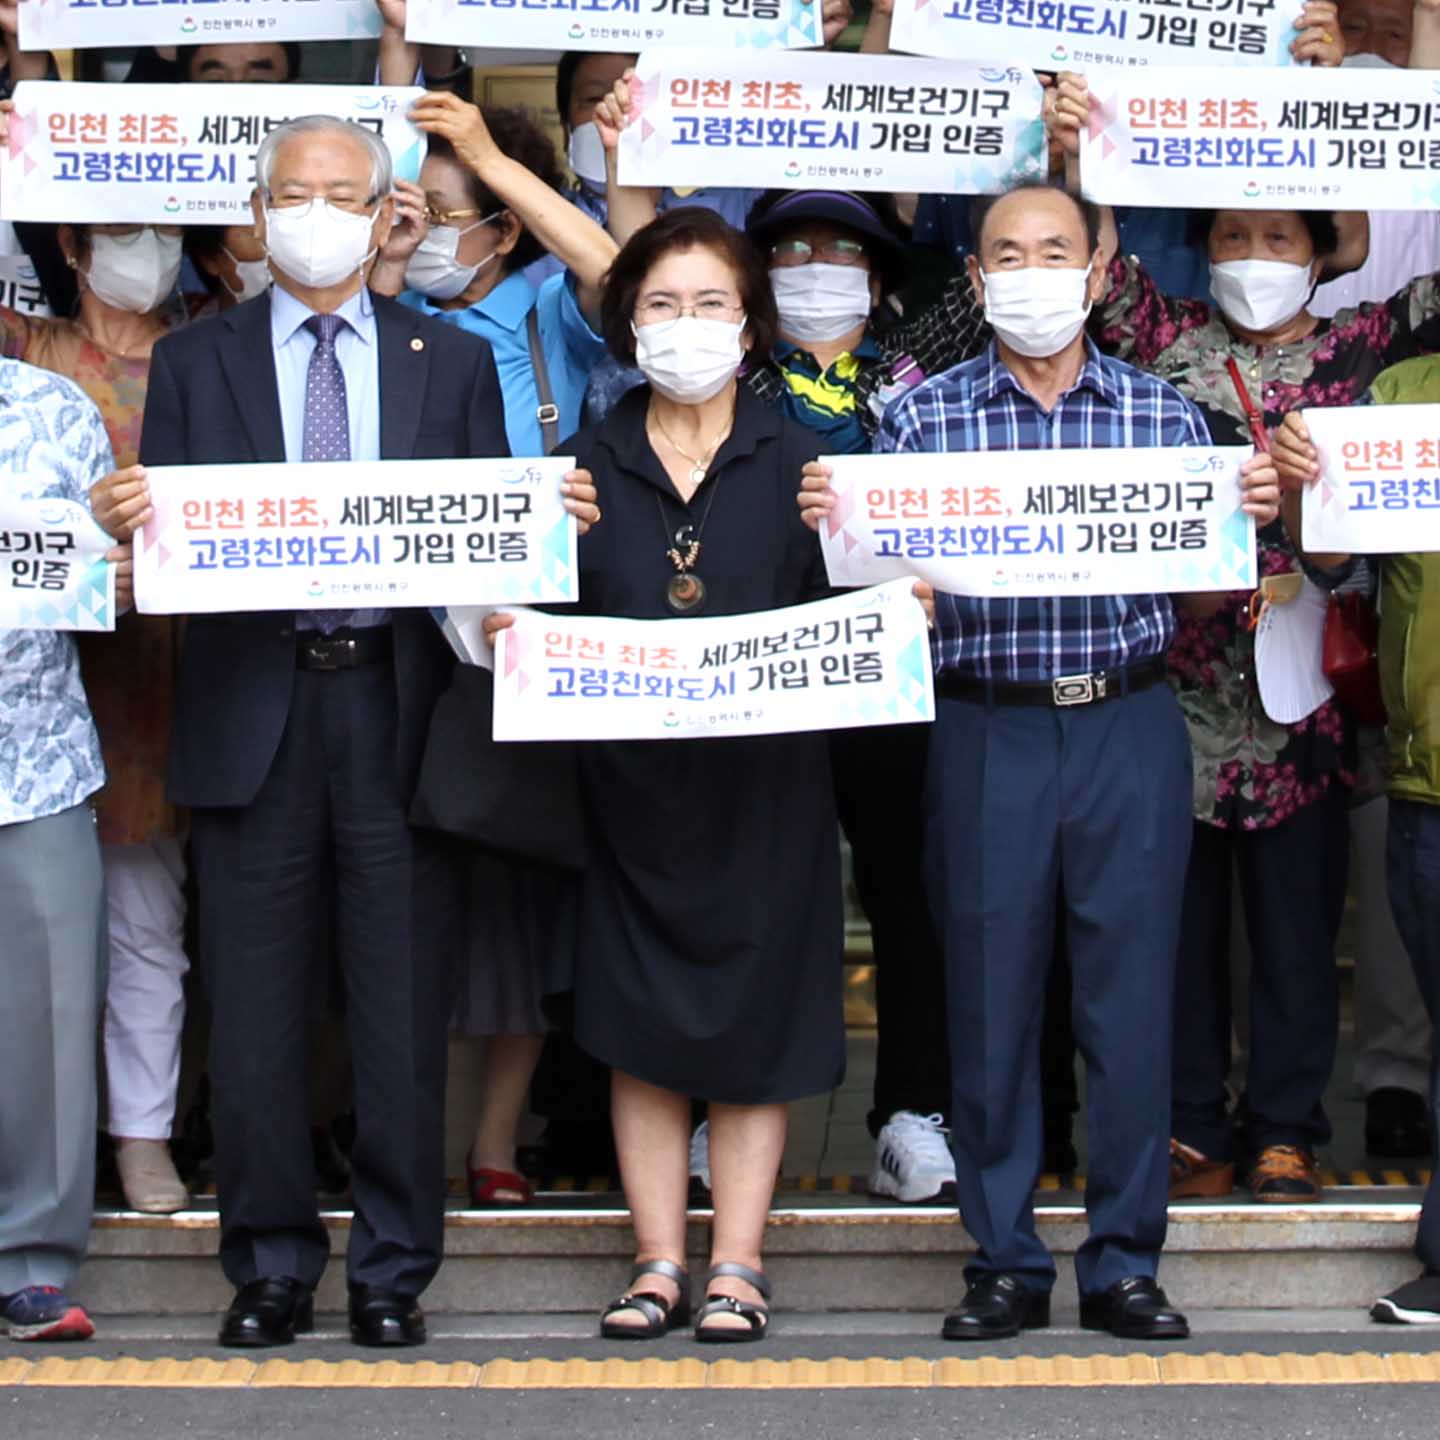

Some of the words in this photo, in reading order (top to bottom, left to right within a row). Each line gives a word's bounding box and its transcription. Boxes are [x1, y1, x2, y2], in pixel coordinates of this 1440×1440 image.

[1136, 13, 1198, 48] 가입
[1208, 20, 1267, 55] 인증
[670, 79, 731, 108] 인천
[742, 81, 810, 110] 최초,
[822, 83, 1010, 118] 세계보건기구
[1128, 99, 1187, 128] 인천
[1200, 99, 1267, 130] 최초,
[671, 117, 859, 150] 고령친화도시
[870, 122, 932, 153] 가입
[943, 125, 1004, 156] 인증
[1131, 137, 1315, 168] 고령친화도시
[1328, 139, 1386, 169] 가입
[1342, 440, 1402, 471] 인천
[183, 500, 244, 530] 인천
[258, 497, 328, 527] 최초,
[340, 493, 532, 526] 세계보건기구
[867, 489, 928, 519] 인천
[942, 487, 1011, 516] 최초,
[1023, 481, 1214, 515] 세계보건기구
[189, 535, 380, 570] 고령친화도시
[393, 533, 454, 564] 가입
[466, 532, 528, 563] 인증
[873, 524, 1064, 559] 고령친화도시
[1077, 522, 1137, 554] 가입
[1150, 518, 1207, 552] 인증
[545, 631, 605, 660] 인천
[698, 613, 885, 669] 세계보건기구
[547, 666, 736, 701] 고령친화도시
[748, 658, 809, 691] 가입
[820, 652, 883, 686] 인증
